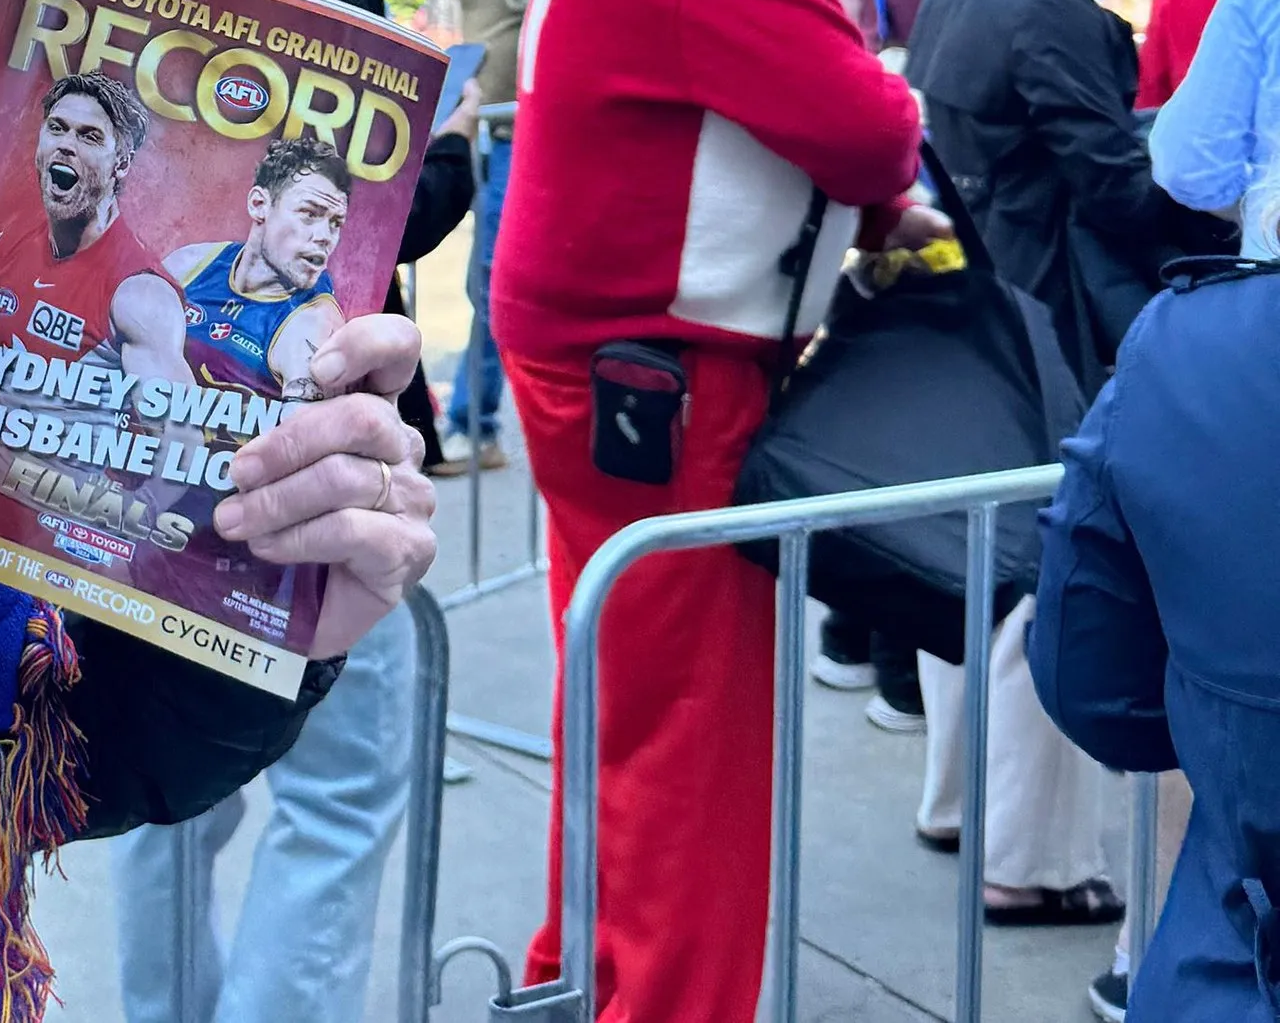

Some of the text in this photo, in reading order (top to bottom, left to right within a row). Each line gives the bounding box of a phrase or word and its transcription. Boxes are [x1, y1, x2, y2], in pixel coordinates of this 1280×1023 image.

[213, 11, 262, 47] AFL
[266, 26, 361, 76] GRAND
[360, 56, 420, 103] FINAL
[219, 81, 263, 107] AFL
[33, 306, 83, 348] QBE
[231, 333, 264, 362] CALTEX
[114, 411, 131, 429] VS
[161, 440, 239, 491] LIO
[2, 457, 195, 552] FINALS
[41, 513, 70, 532] AFL
[90, 533, 130, 557] TOYOTA
[16, 555, 44, 581] THE
[47, 572, 72, 589] AFL
[73, 577, 155, 625] RECORD
[223, 596, 260, 619] SEPTEMBER
[161, 615, 277, 674] CYGNETT
